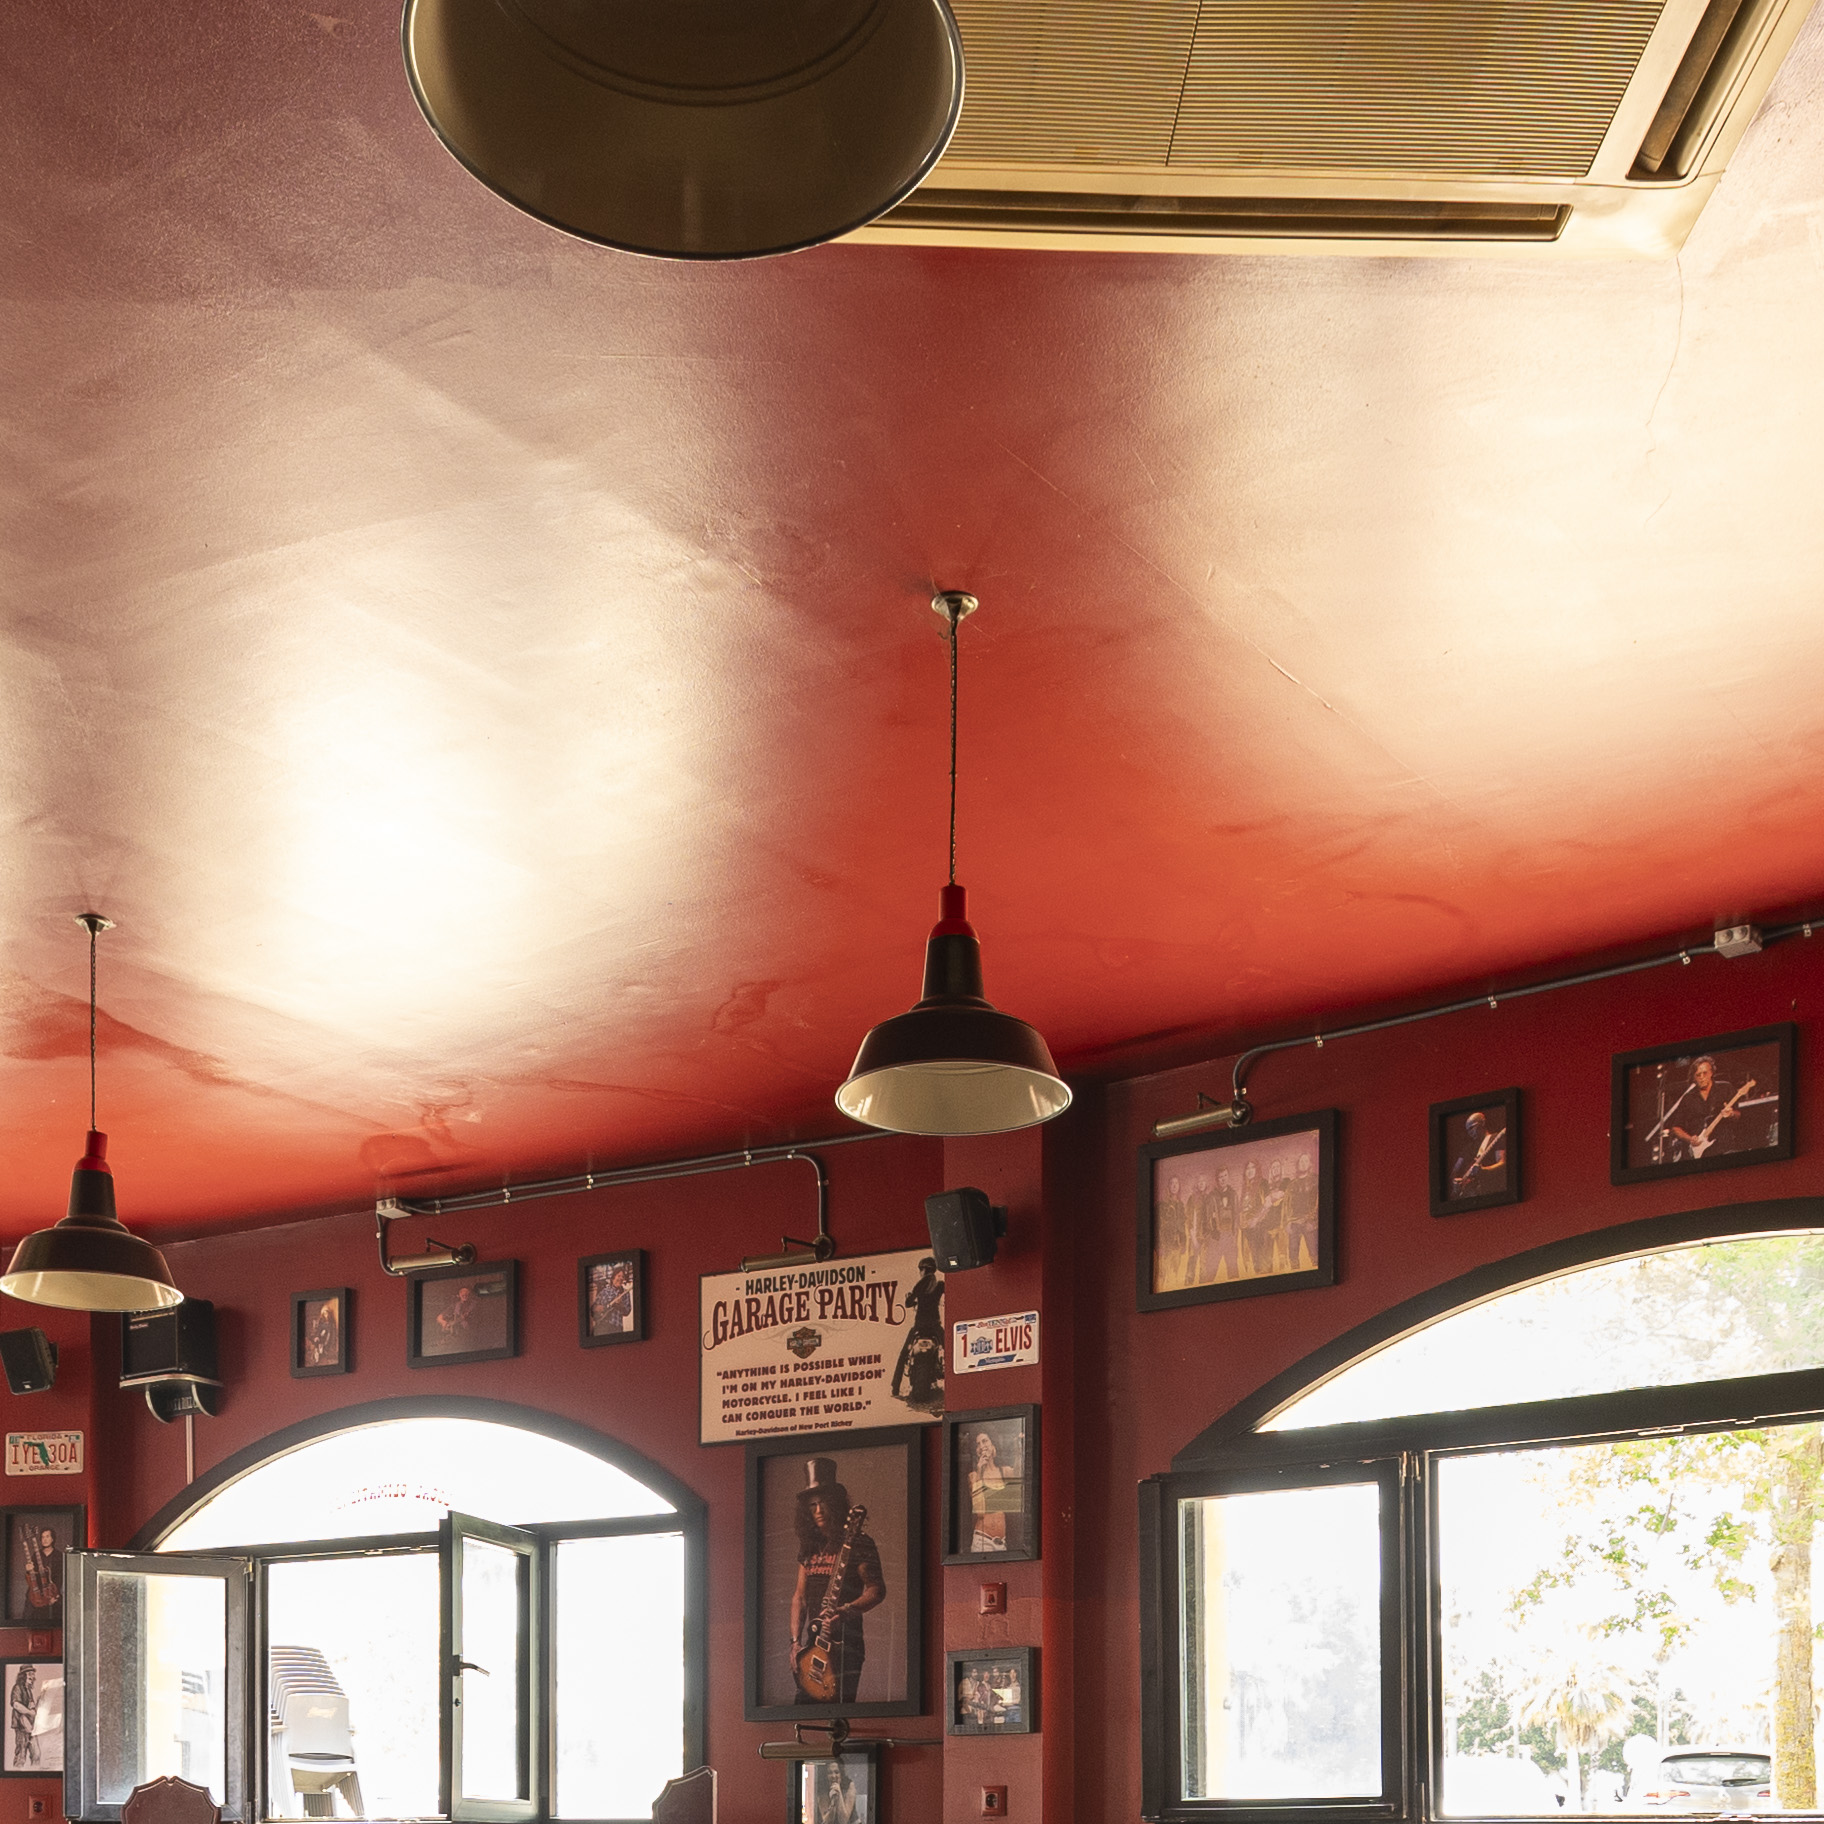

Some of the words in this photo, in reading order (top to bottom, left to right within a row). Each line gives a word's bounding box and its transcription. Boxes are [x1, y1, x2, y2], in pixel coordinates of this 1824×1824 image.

[745, 1265, 866, 1296] HARLEY-DAVIDSON
[703, 1289, 810, 1350] GARAGE
[814, 1280, 907, 1326] PARTY
[961, 1333, 968, 1358] 1
[995, 1324, 1033, 1354] ELVIS
[780, 1363, 790, 1374] IS
[793, 1357, 845, 1372] POSSIBLE
[848, 1353, 882, 1367] WHEN
[722, 1384, 738, 1395] I'M
[741, 1382, 757, 1393] ON
[760, 1380, 777, 1391] MY
[795, 1392, 800, 1402] I
[803, 1390, 827, 1401] FEEL
[830, 1387, 855, 1398] LIKE
[857, 1385, 863, 1396] I
[722, 1413, 743, 1424] CAN
[745, 1408, 797, 1421] CONQUER
[799, 1405, 820, 1416] THE
